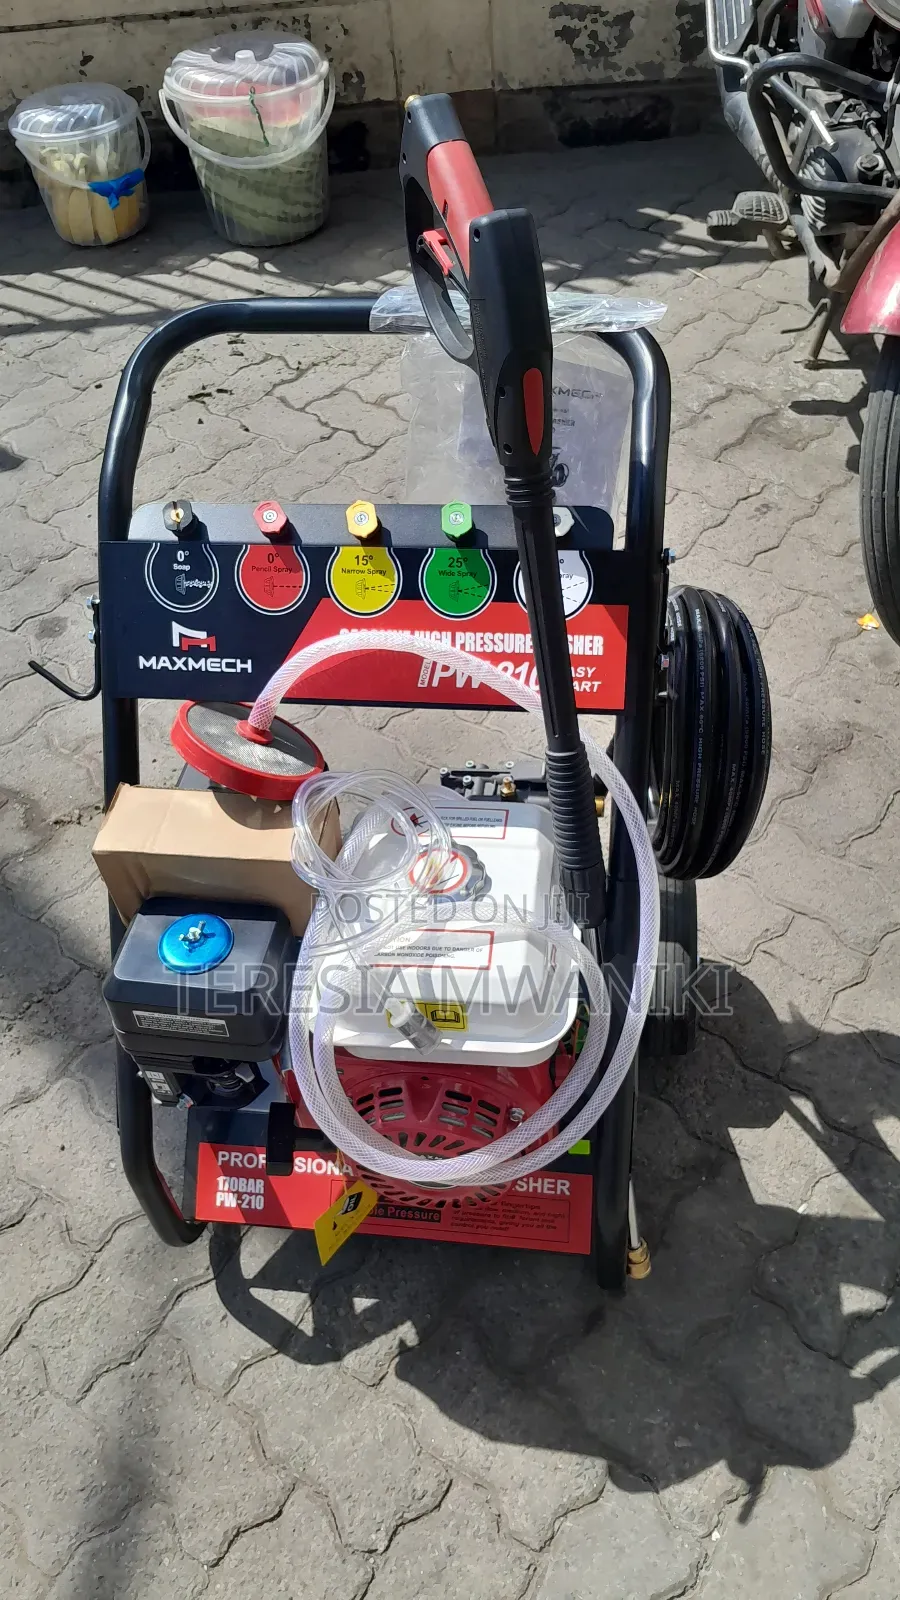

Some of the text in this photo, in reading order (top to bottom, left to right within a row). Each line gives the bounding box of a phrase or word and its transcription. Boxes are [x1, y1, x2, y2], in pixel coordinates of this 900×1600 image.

[354, 554, 374, 566] 15°
[447, 556, 469, 568] 25°
[173, 563, 191, 572] Soap
[251, 565, 293, 575] Pencil Spray
[341, 567, 387, 577] Narrow Spray
[438, 569, 478, 579] Wide Spray
[455, 631, 534, 654] PRESSURE
[567, 634, 604, 656] SHER
[138, 655, 252, 673] MAXMECH
[419, 660, 432, 686] MODEL
[573, 680, 602, 693] ART
[217, 1150, 571, 1196] PROFSIONA SHER
[216, 1175, 265, 1195] 170BAR
[215, 1191, 265, 1210] PW-210
[387, 1206, 441, 1221] Pressure
